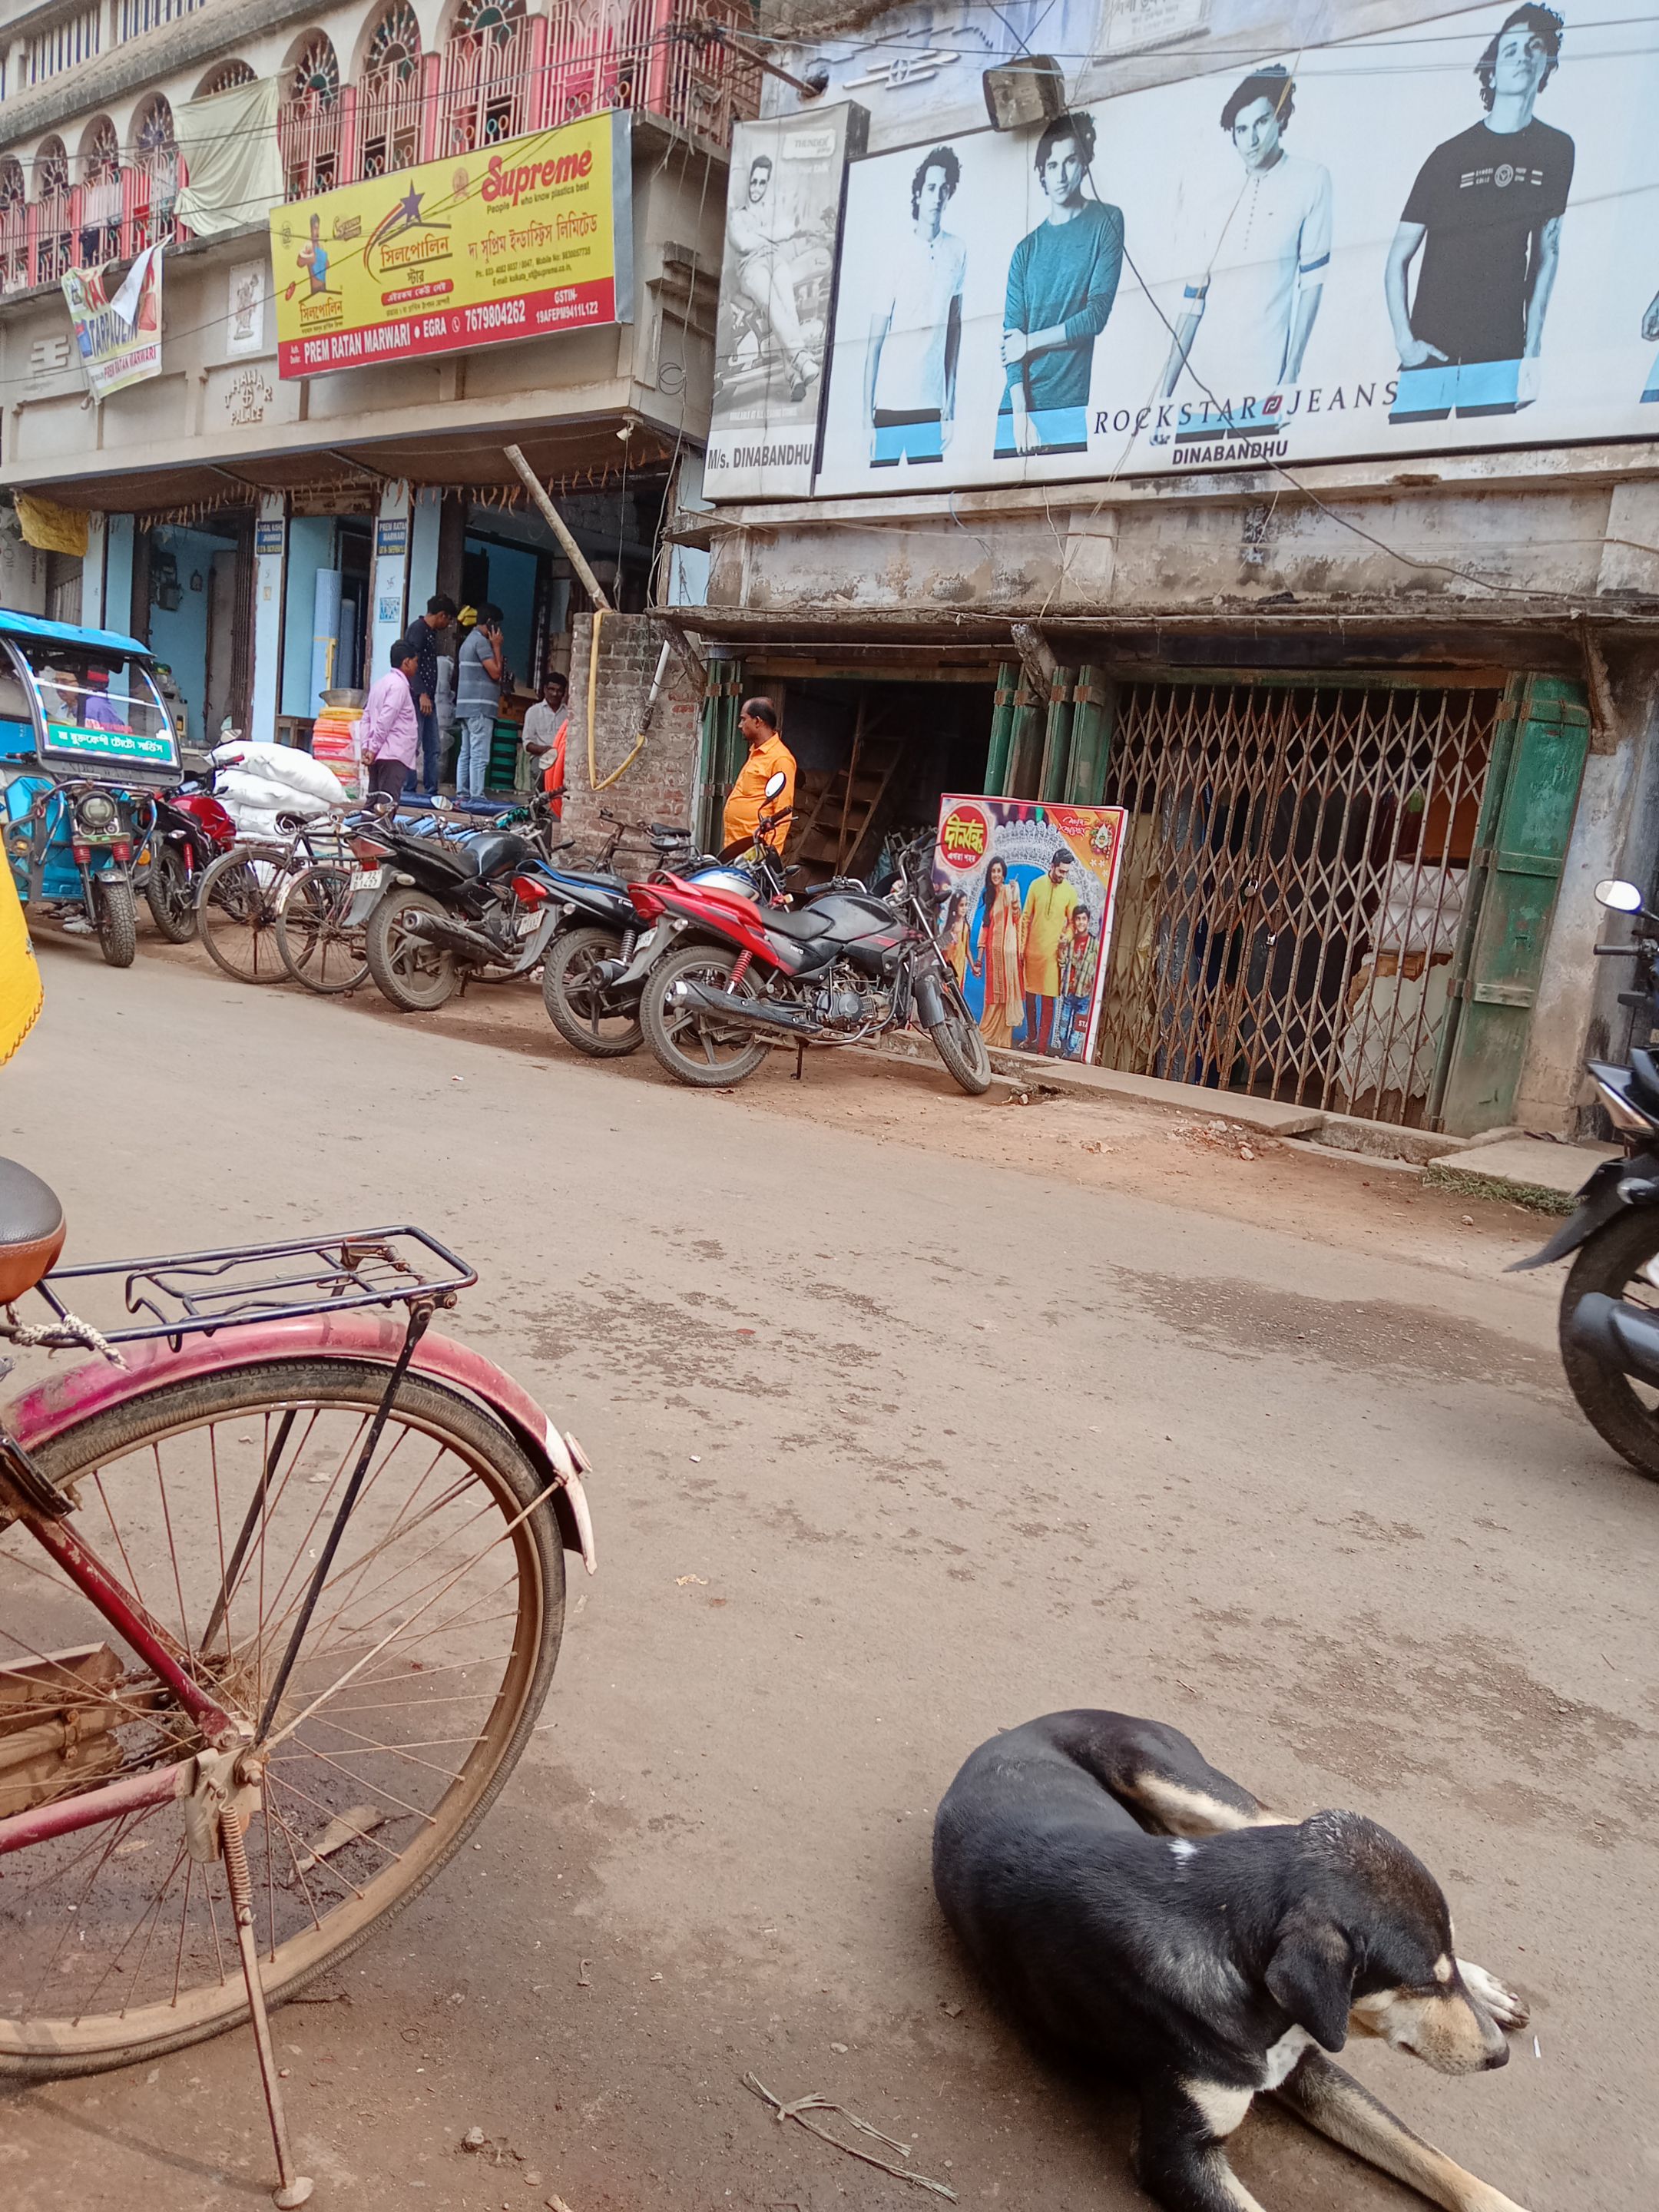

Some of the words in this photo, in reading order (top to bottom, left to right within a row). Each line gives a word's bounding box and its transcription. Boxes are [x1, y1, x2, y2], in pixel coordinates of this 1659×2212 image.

[482, 150, 593, 207] Supreme
[487, 202, 510, 214] People
[521, 196, 533, 206] who
[534, 193, 550, 203] know
[551, 186, 575, 200] plastics
[576, 181, 590, 192] best
[380, 233, 450, 267] সিলপোলিন
[300, 296, 343, 323] সিলপোলিন
[555, 287, 578, 304] GSTIN-
[303, 339, 329, 365] PREM
[331, 333, 362, 359] RATAN
[363, 323, 411, 353] MARWARI
[423, 316, 448, 338] EGRA
[465, 299, 526, 333] 7679804262
[231, 406, 263, 426] PALACE
[1094, 396, 1257, 435] ROCKSTAR
[1286, 380, 1399, 416] JEANS
[707, 448, 729, 469] M/s.
[733, 443, 813, 469] DINABANDHU
[1172, 439, 1288, 465] DINABANDHU
